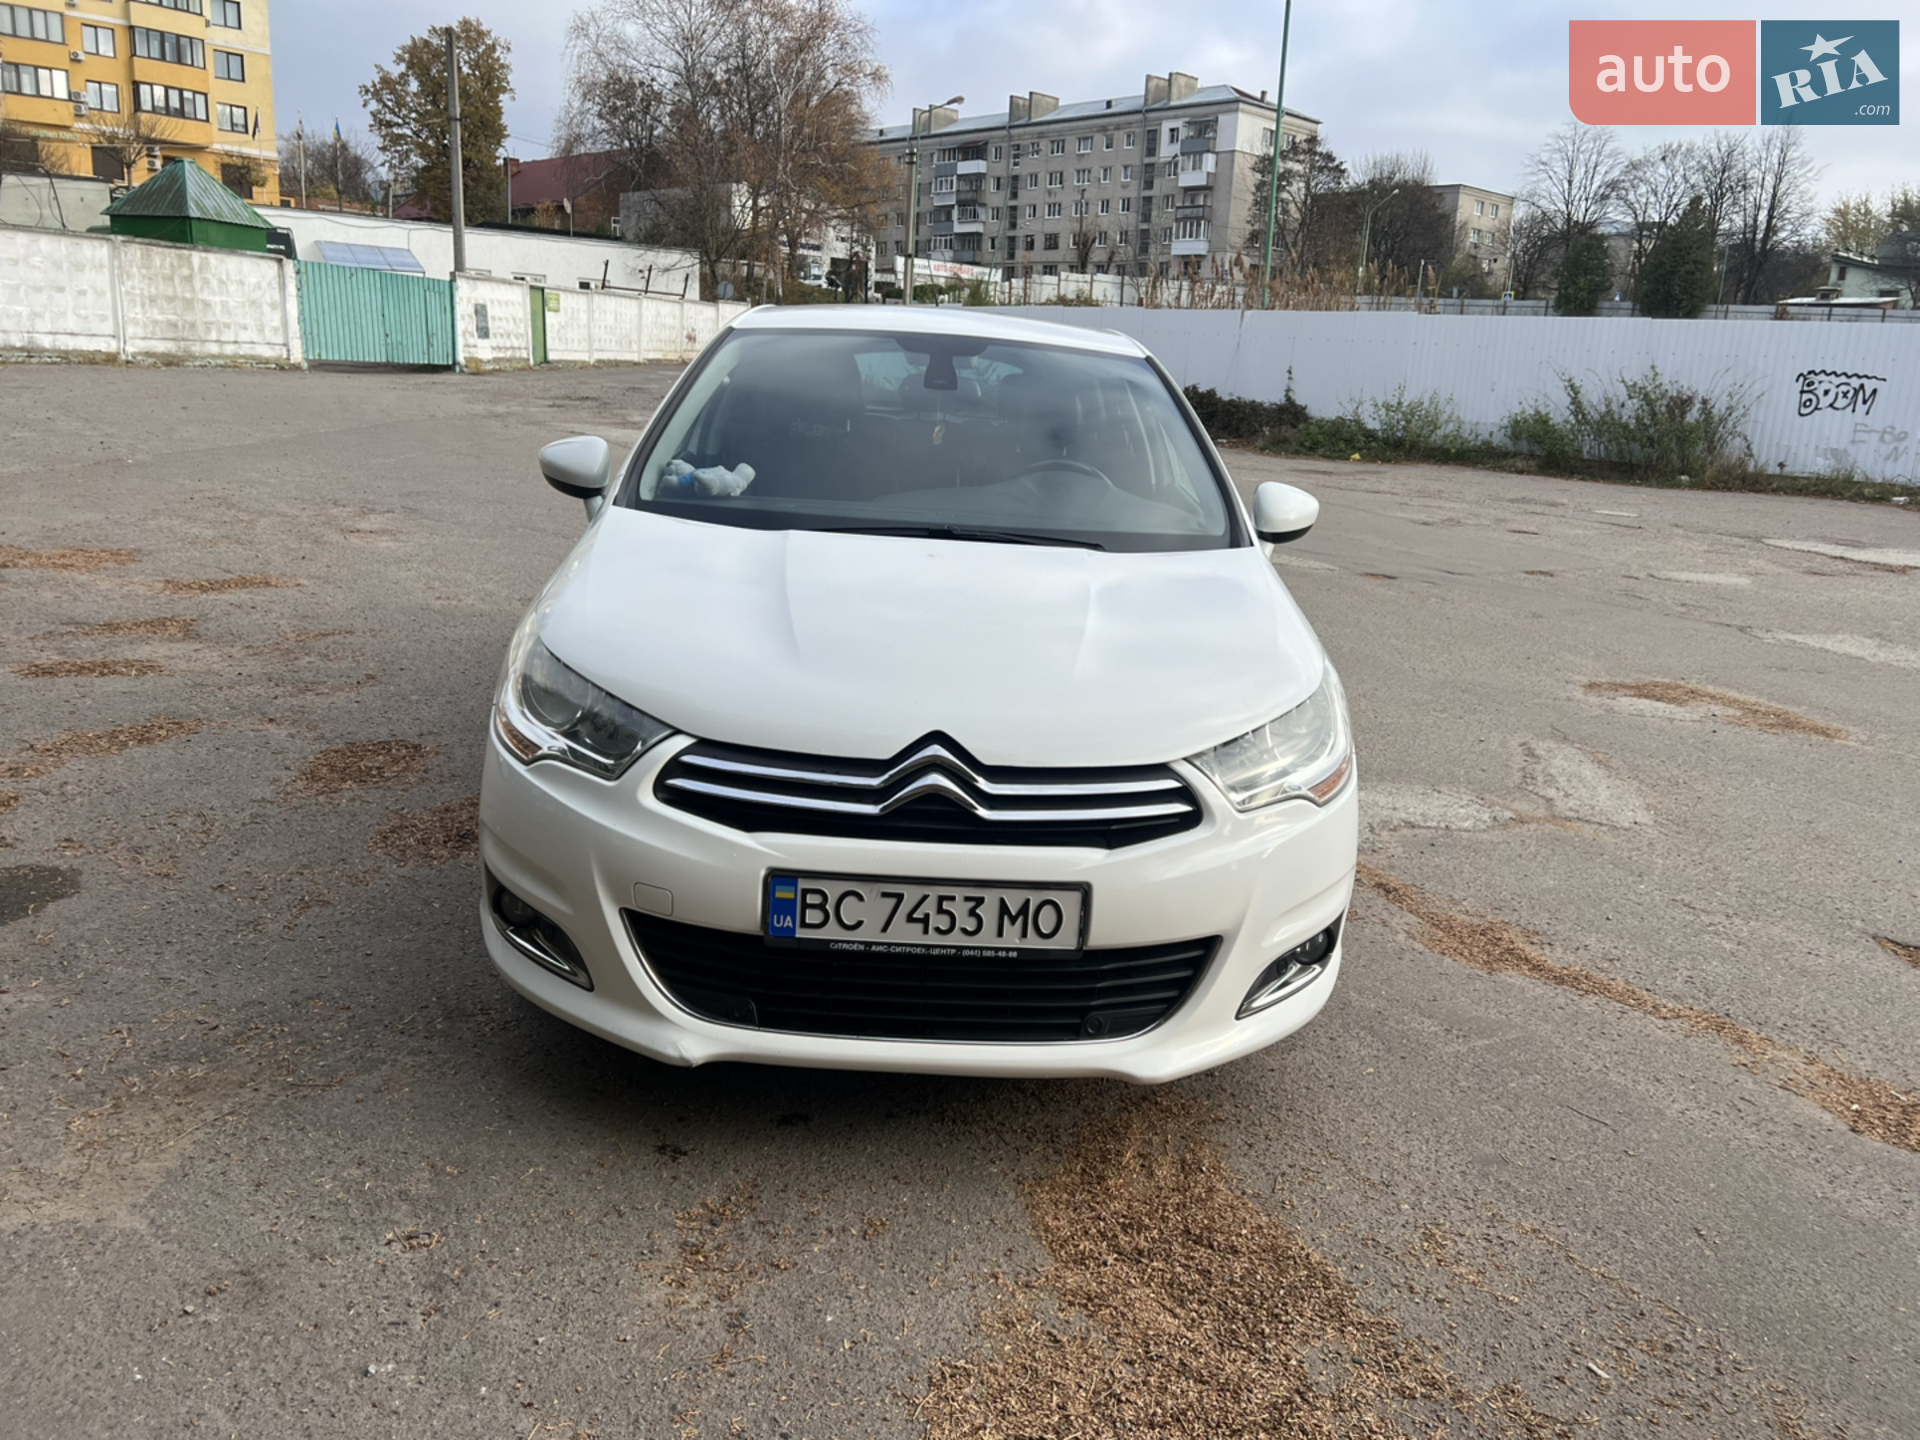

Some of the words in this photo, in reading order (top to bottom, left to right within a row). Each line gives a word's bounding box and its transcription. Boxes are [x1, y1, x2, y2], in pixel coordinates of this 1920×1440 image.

[773, 914, 793, 928] UA
[800, 887, 866, 931] BC
[880, 891, 986, 937] 7453
[997, 896, 1064, 940] MO
